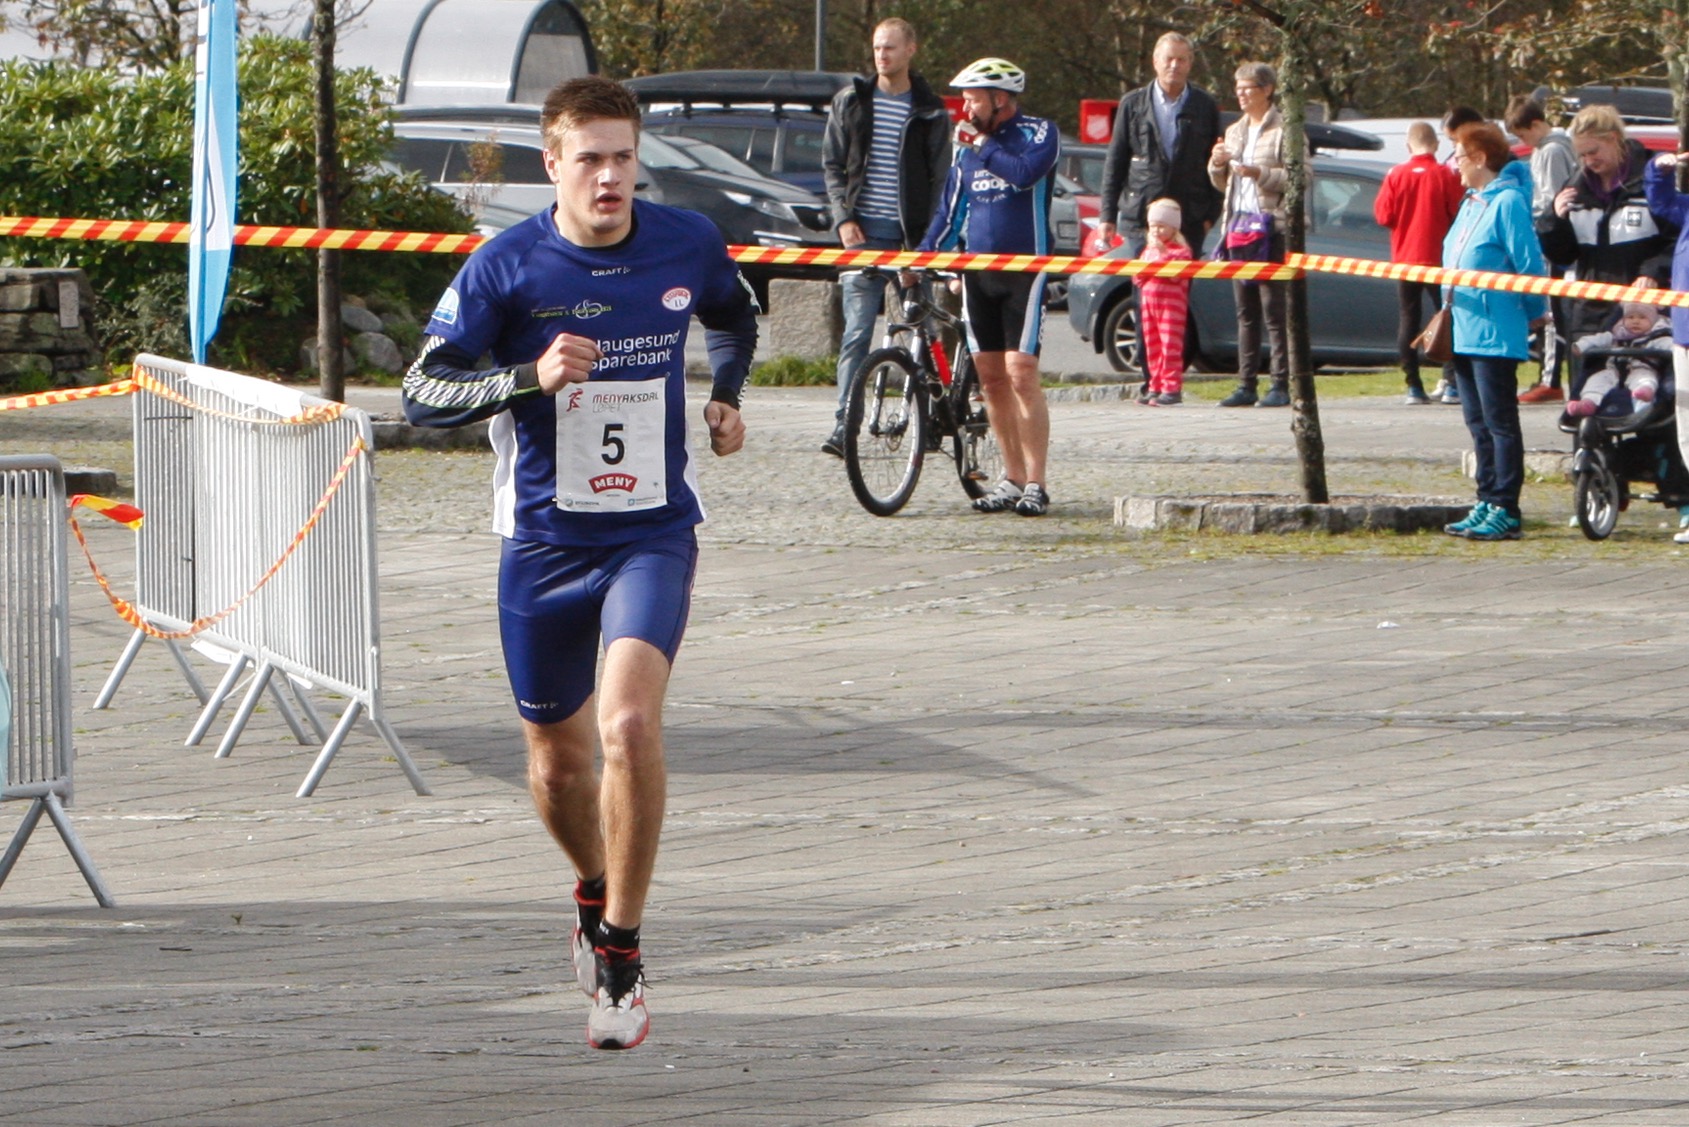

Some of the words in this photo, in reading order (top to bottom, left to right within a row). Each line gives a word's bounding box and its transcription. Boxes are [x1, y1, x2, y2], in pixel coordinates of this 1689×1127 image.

[592, 268, 622, 277] CRAFT
[601, 423, 625, 465] 5
[594, 476, 633, 489] MENY
